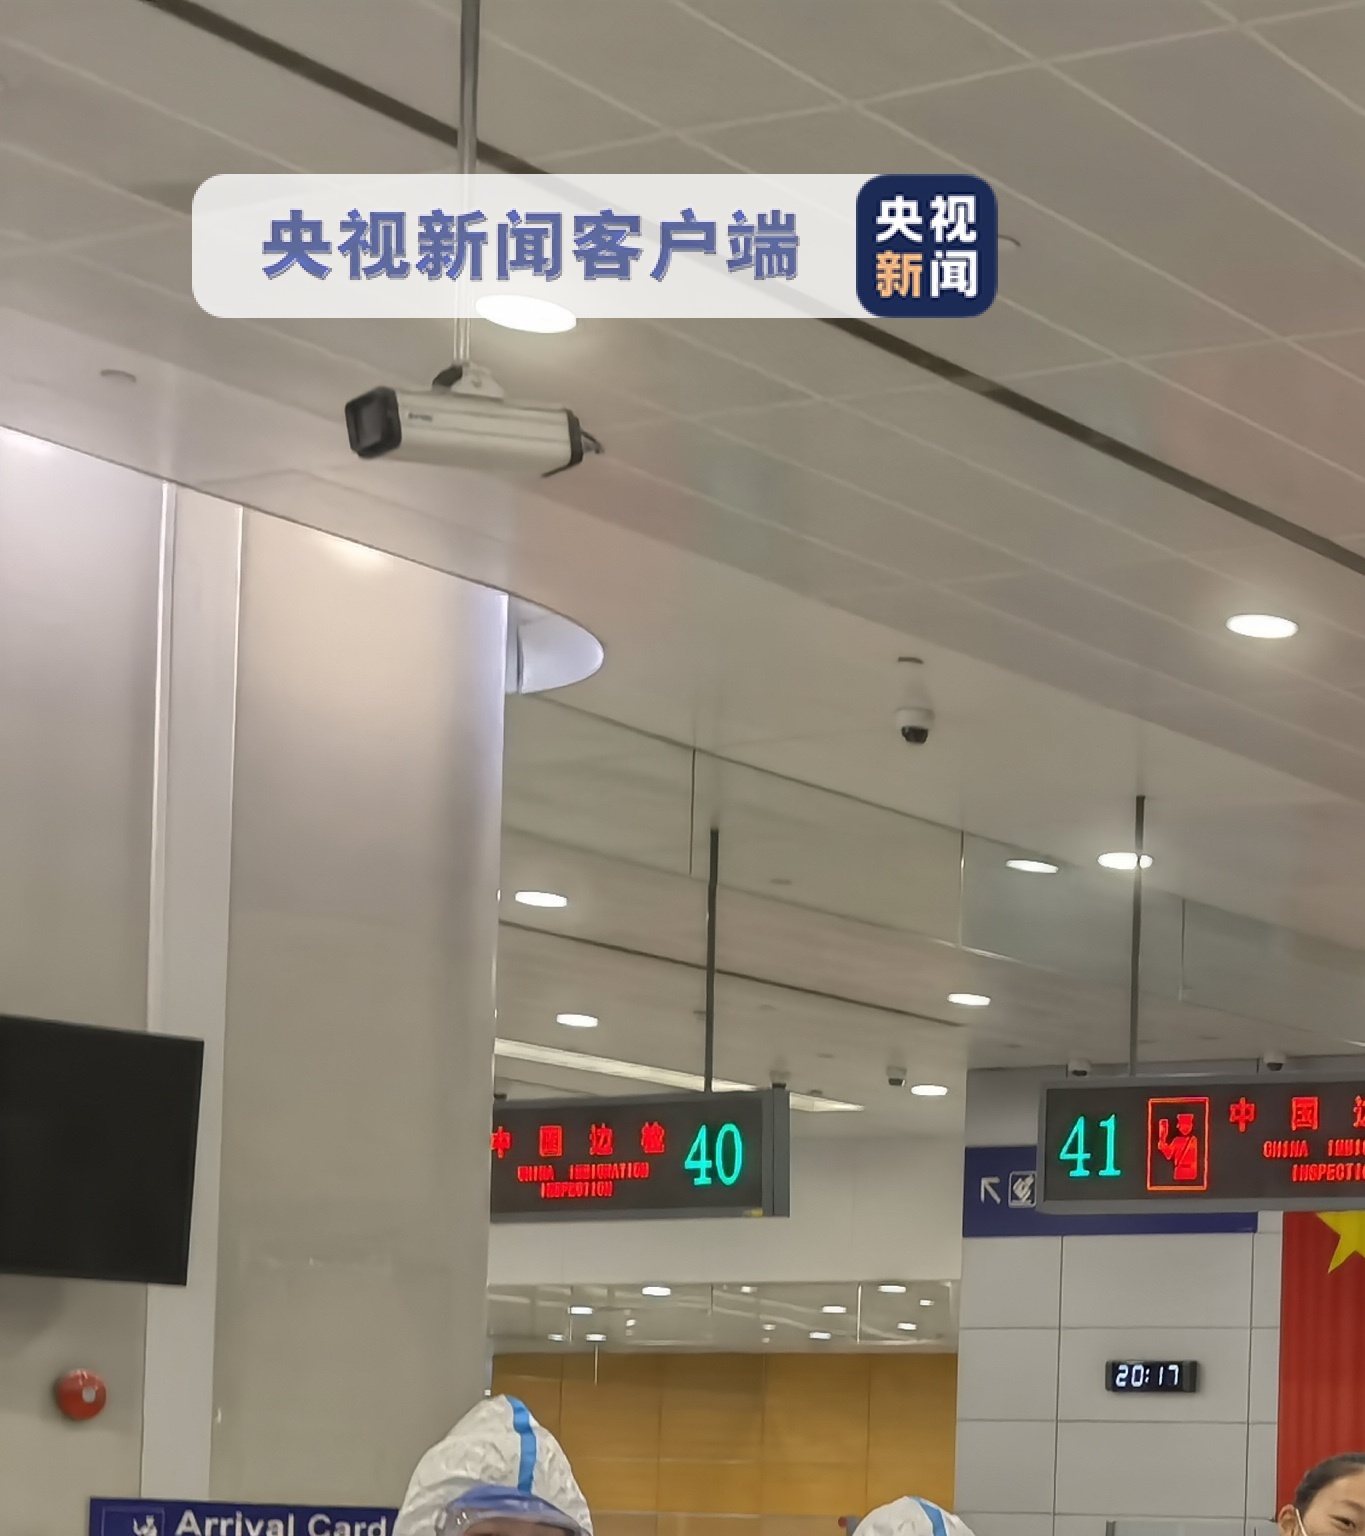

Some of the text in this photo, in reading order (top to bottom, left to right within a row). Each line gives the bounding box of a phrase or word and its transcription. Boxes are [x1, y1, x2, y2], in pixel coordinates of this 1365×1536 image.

[684, 1123, 743, 1186] 40
[1058, 1113, 1121, 1178] 41
[1262, 1140, 1309, 1158] CHINA
[1113, 1361, 1180, 1390] 20:17
